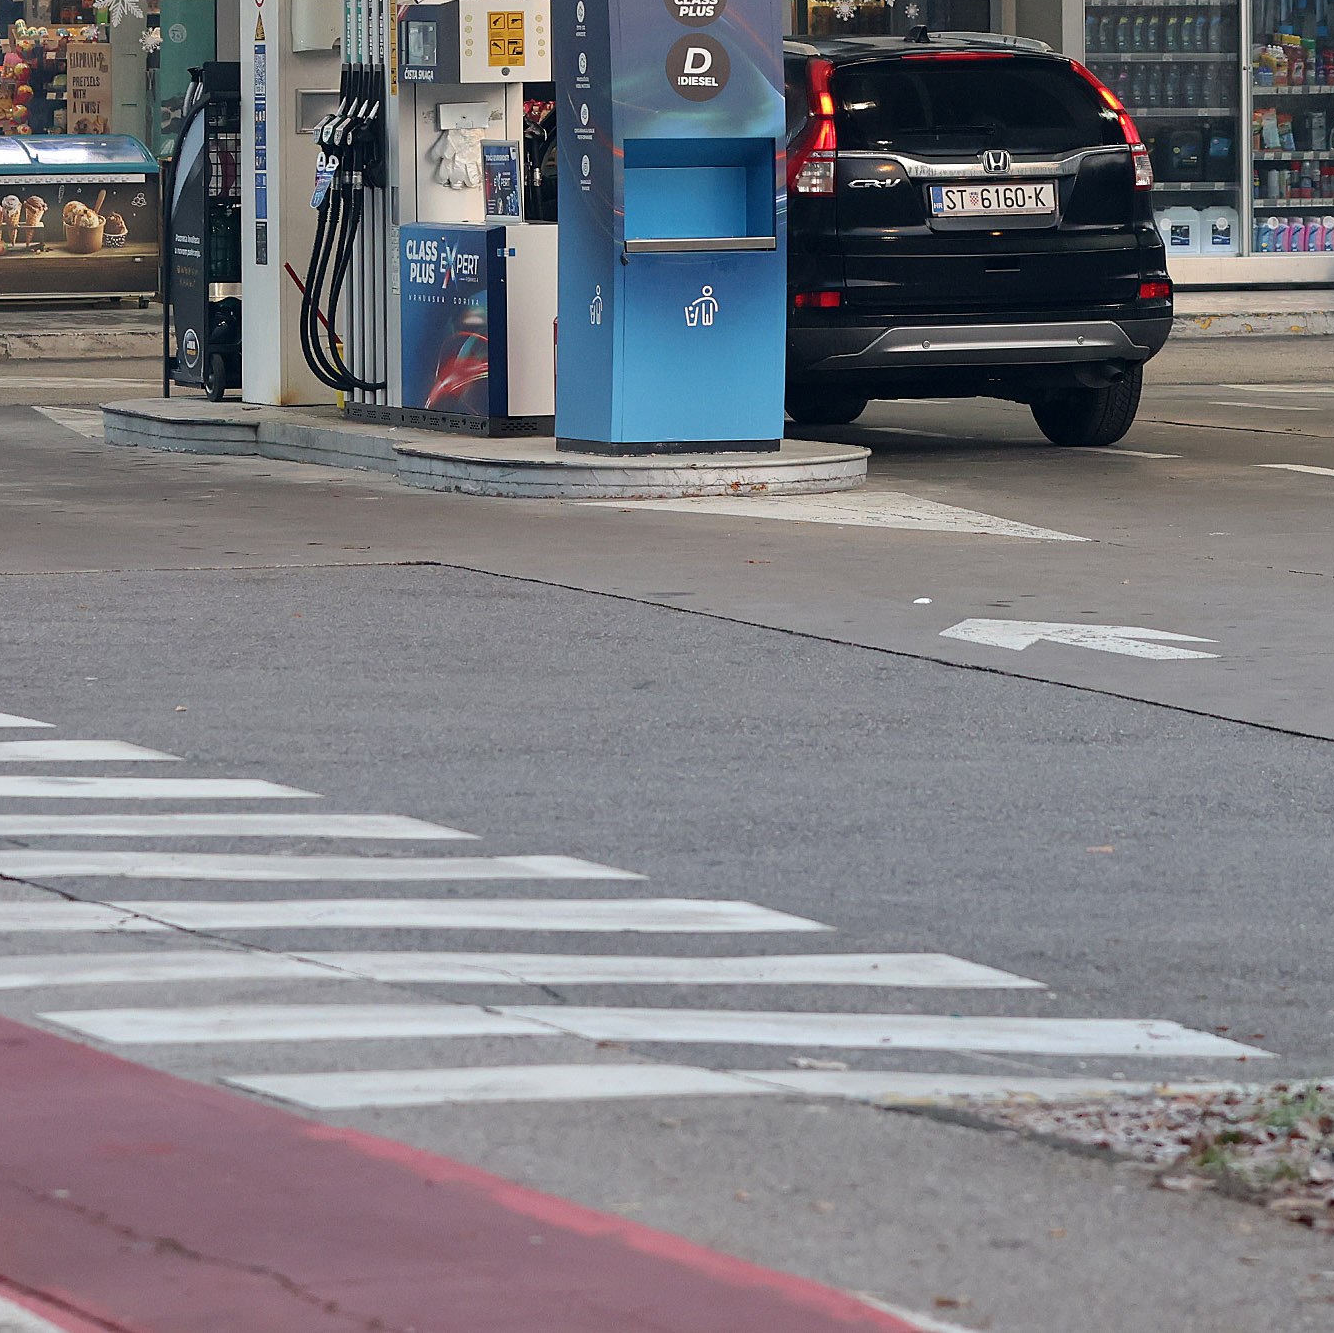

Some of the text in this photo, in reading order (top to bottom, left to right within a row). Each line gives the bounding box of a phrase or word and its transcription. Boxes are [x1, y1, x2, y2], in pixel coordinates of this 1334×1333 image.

[679, 6, 714, 17] PLUS
[683, 47, 712, 74] D
[72, 76, 100, 87] PRETZELS
[72, 89, 86, 99] WITH
[72, 101, 100, 114] A TWIST
[847, 178, 901, 189] CR-V
[945, 186, 1046, 210] ST 6160-K
[933, 202, 943, 210] HR
[406, 239, 438, 262] CLASS
[409, 262, 435, 284] PLUS
[440, 246, 480, 289] EXPERT
